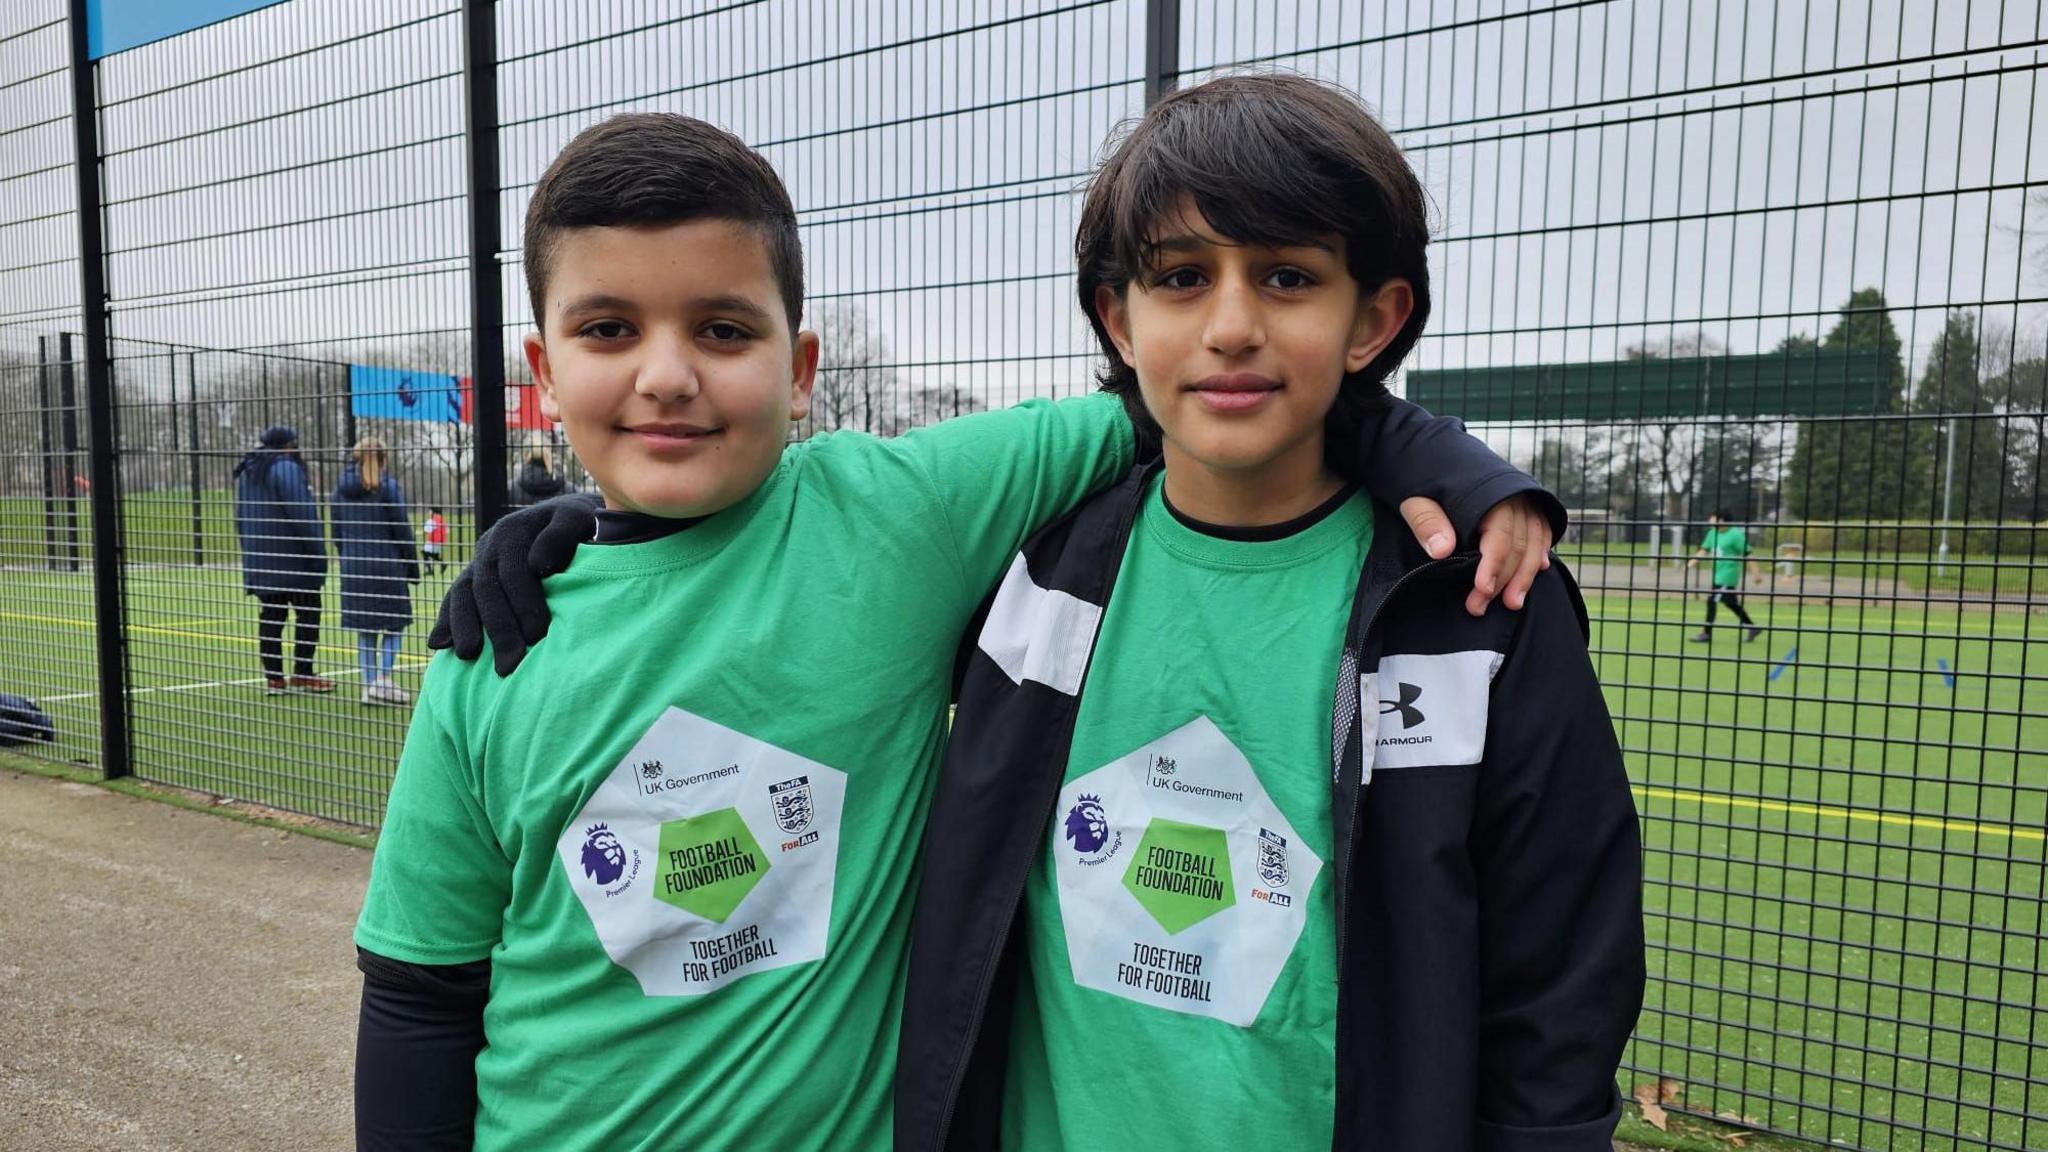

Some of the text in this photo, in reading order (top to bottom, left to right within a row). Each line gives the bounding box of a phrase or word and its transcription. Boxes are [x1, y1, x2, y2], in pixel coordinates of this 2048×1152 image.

[1380, 735, 1432, 746] ARMOUR
[645, 763, 740, 795] UK Government
[1153, 777, 1243, 803] UK Government
[669, 837, 743, 871] FOOTBALL
[1079, 830, 1123, 866] Premier League
[1147, 846, 1216, 878] FOOTBALL
[605, 849, 642, 898] Premier League
[664, 853, 756, 895] FOUNDATION
[1135, 866, 1224, 901] FOUNDATION
[682, 938, 778, 982] FOR FOOTBALL
[689, 925, 760, 960] TOGETHER
[1133, 942, 1202, 975] TOGETHER
[1117, 963, 1211, 1002] FOR FOOTBALL
